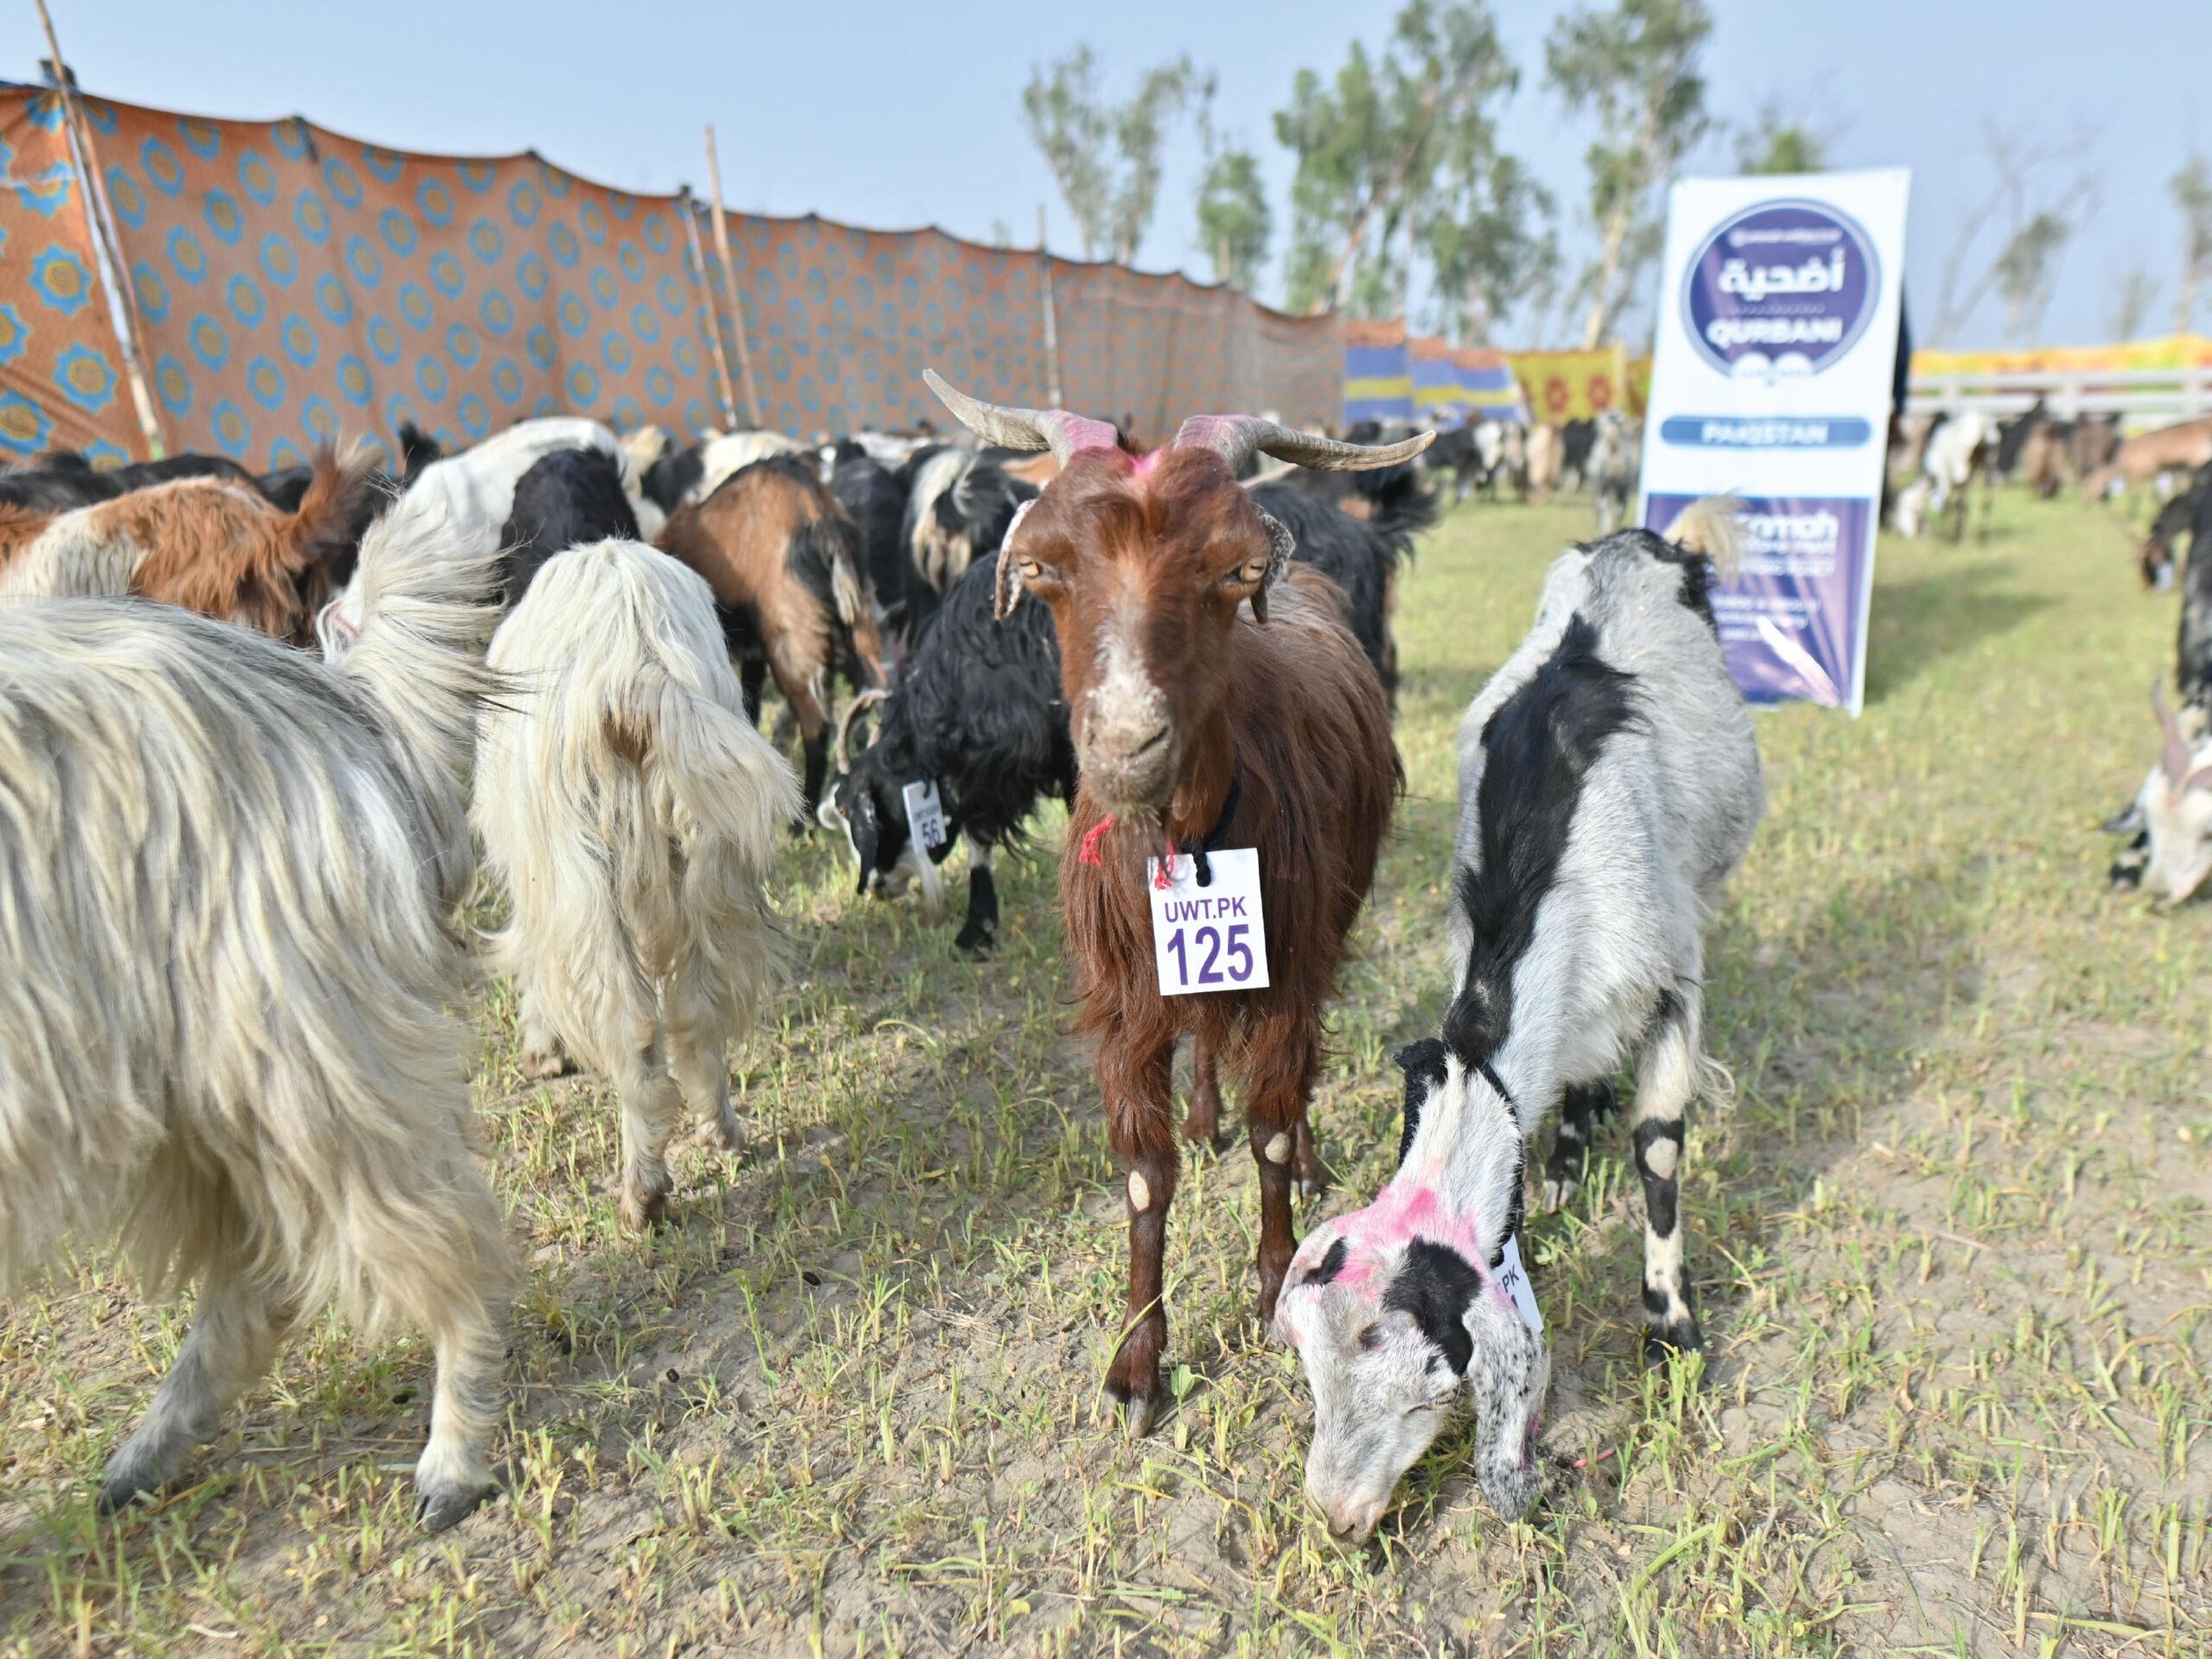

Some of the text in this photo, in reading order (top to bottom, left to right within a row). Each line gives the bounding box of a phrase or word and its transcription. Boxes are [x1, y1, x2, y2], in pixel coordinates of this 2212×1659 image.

[1718, 246, 1847, 302] أضحية
[1706, 316, 1844, 349] QURBANI
[1700, 420, 1829, 446] PAKISTAN
[922, 818, 942, 849] 56
[1164, 896, 1248, 923] UWT.PK
[1167, 924, 1254, 986] 125
